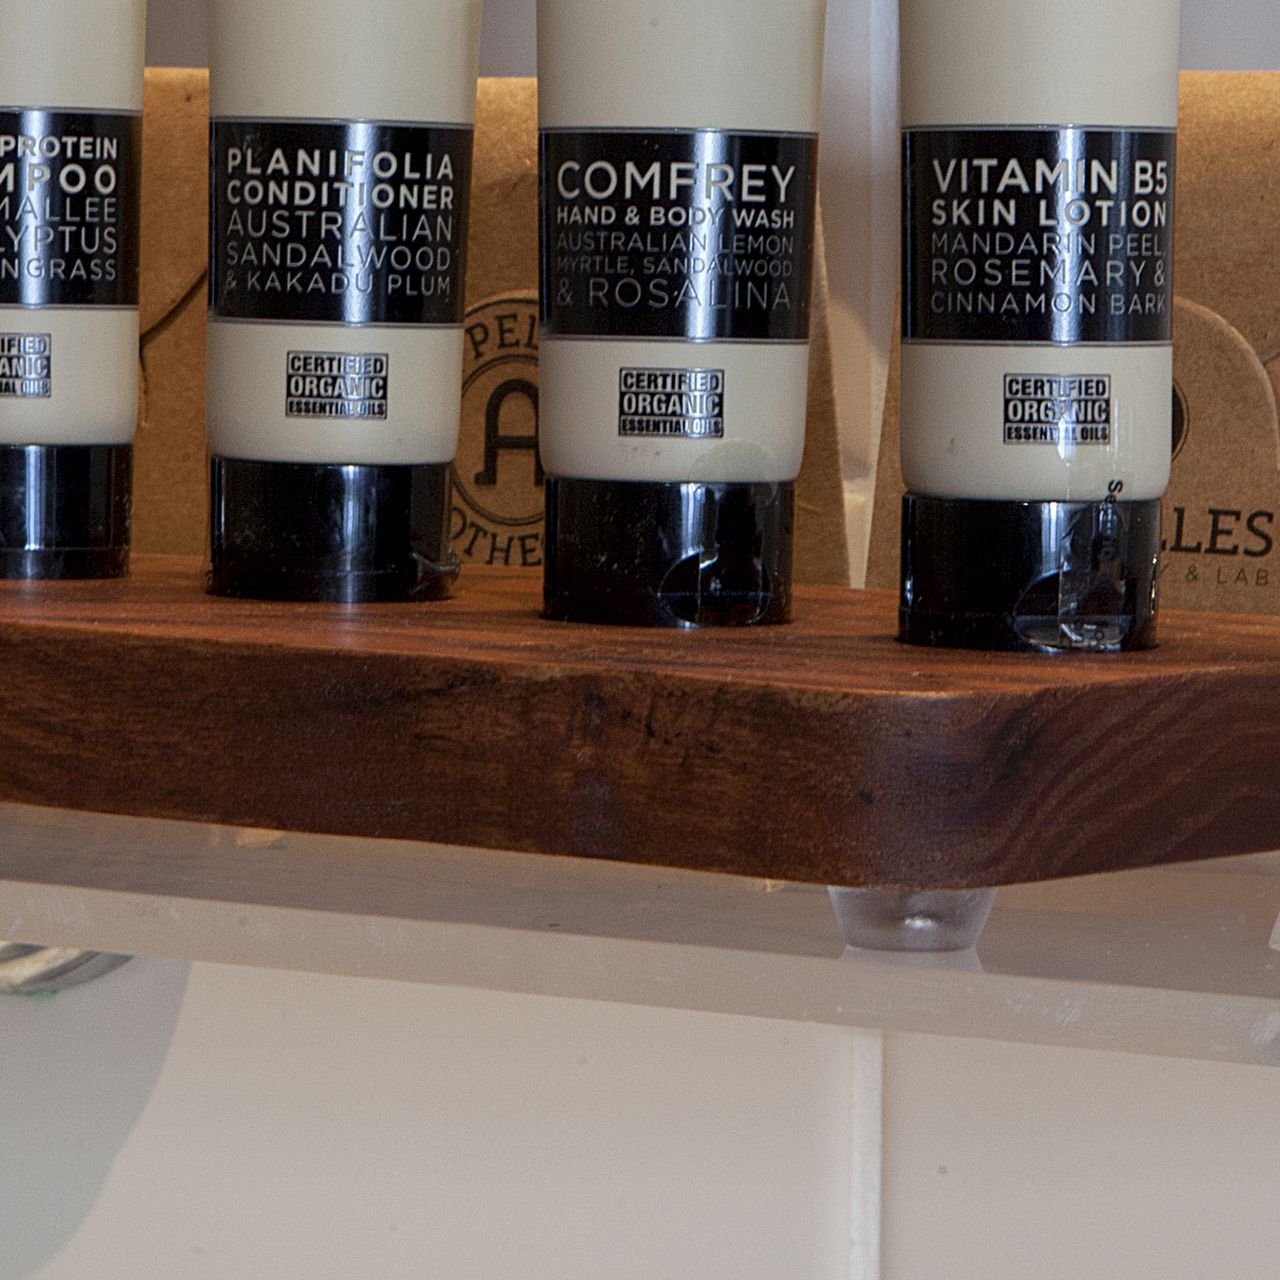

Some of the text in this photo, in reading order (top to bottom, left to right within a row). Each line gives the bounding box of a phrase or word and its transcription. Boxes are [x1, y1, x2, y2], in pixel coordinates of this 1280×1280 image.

[228, 147, 454, 180] PLANIFOLIA
[557, 161, 795, 203] COMFREY
[933, 158, 1168, 195] VITAMIN B5
[227, 180, 454, 210] CONDITIONER
[226, 208, 452, 242] AUSTRALIAN
[557, 206, 795, 230] HAND & BODY WASH
[932, 198, 1166, 228] SKIN LOTION
[557, 231, 794, 255] AUSTRALIAN LEMON
[931, 232, 1095, 256] MANDARIN
[226, 241, 451, 271] SANDALWOOD
[557, 256, 793, 278] MYRTLE, SANDALWOOD
[225, 271, 450, 296] & KAKADU PLUM
[932, 258, 1166, 287] ROSEMARY &
[556, 278, 793, 311] & ROSALINA
[931, 292, 1166, 315] CINNAMON BARK
[290, 355, 384, 375] CERTIFIED
[290, 376, 384, 398] ORGANIC
[623, 372, 720, 391] CERTIFIED
[1008, 378, 1106, 397] CERTIFIED
[289, 400, 384, 416] ESSENTIAL OILS
[623, 393, 721, 416] ORGANIC
[1008, 399, 1107, 422] ORGANIC
[622, 418, 722, 434] ESSENTIAL OILS
[1080, 425, 1108, 441] OILS
[1186, 565, 1199, 582] &
[1217, 566, 1270, 586] LAB
